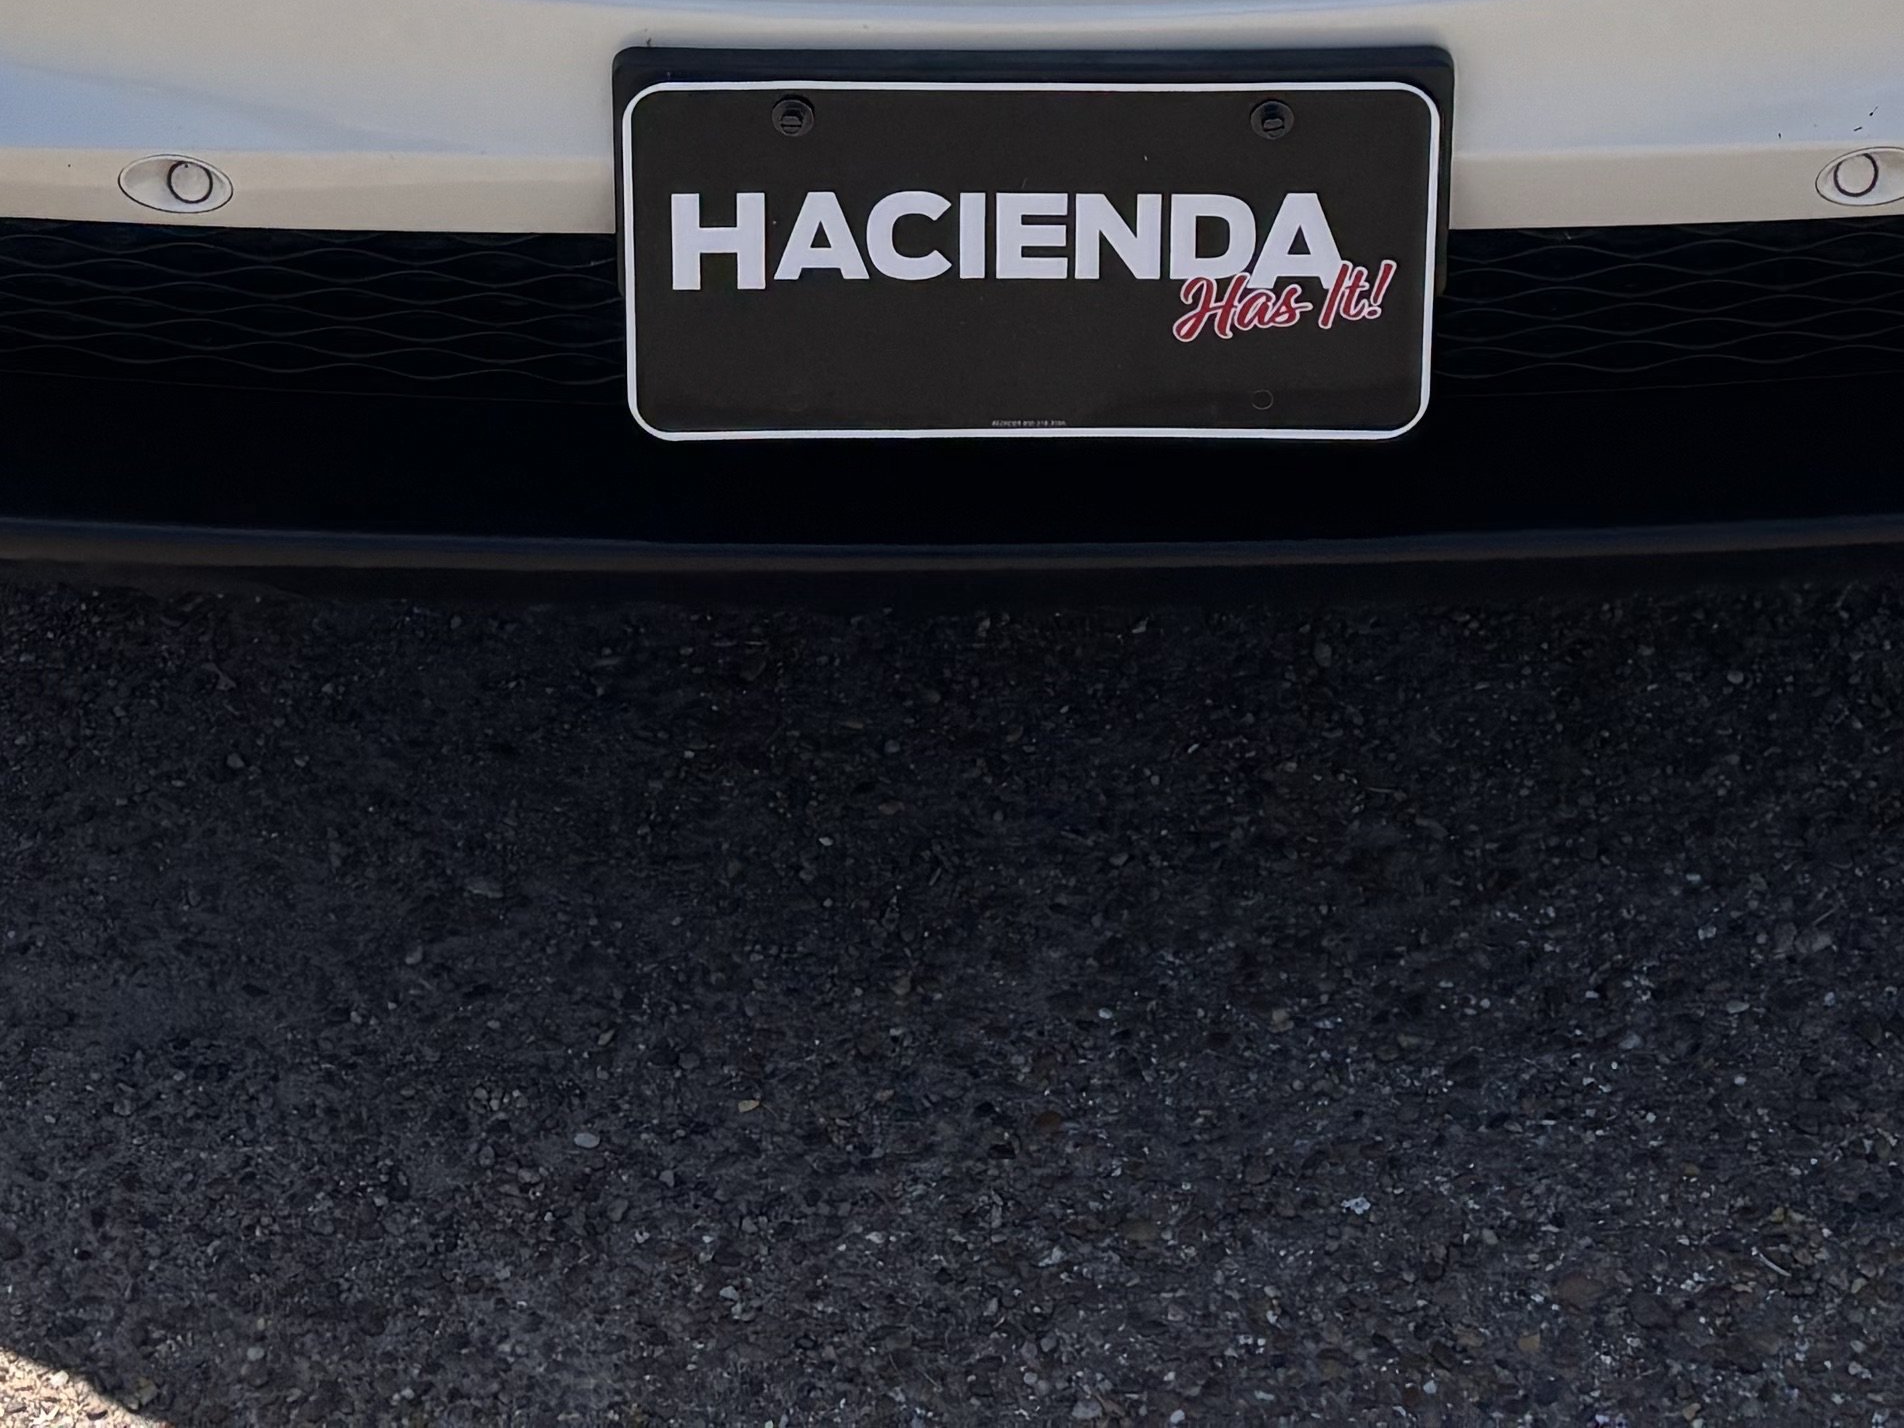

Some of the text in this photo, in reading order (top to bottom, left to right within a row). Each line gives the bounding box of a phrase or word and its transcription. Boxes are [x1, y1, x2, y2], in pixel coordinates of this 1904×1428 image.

[670, 190, 1346, 291] HACIENDA
[1172, 258, 1397, 343] Has It!
